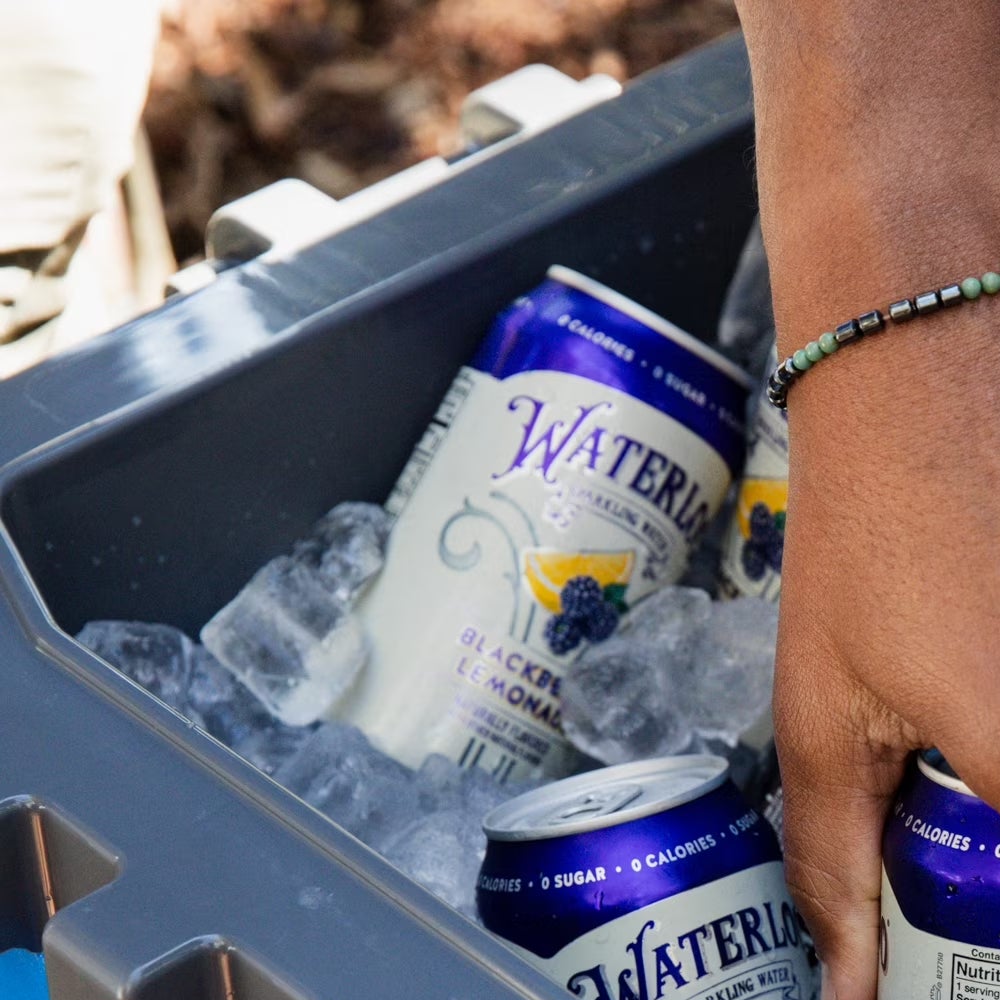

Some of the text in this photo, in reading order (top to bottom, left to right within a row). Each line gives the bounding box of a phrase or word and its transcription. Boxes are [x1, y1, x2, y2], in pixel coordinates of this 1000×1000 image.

[568, 319, 635, 362] CALORIES
[911, 819, 971, 851] CALORIES
[554, 867, 606, 888] SUGAR
[631, 858, 642, 872] 0
[645, 834, 716, 868] CALORIES
[757, 967, 788, 987] WATER
[956, 982, 961, 990] 1
[964, 984, 1000, 1000] serving
